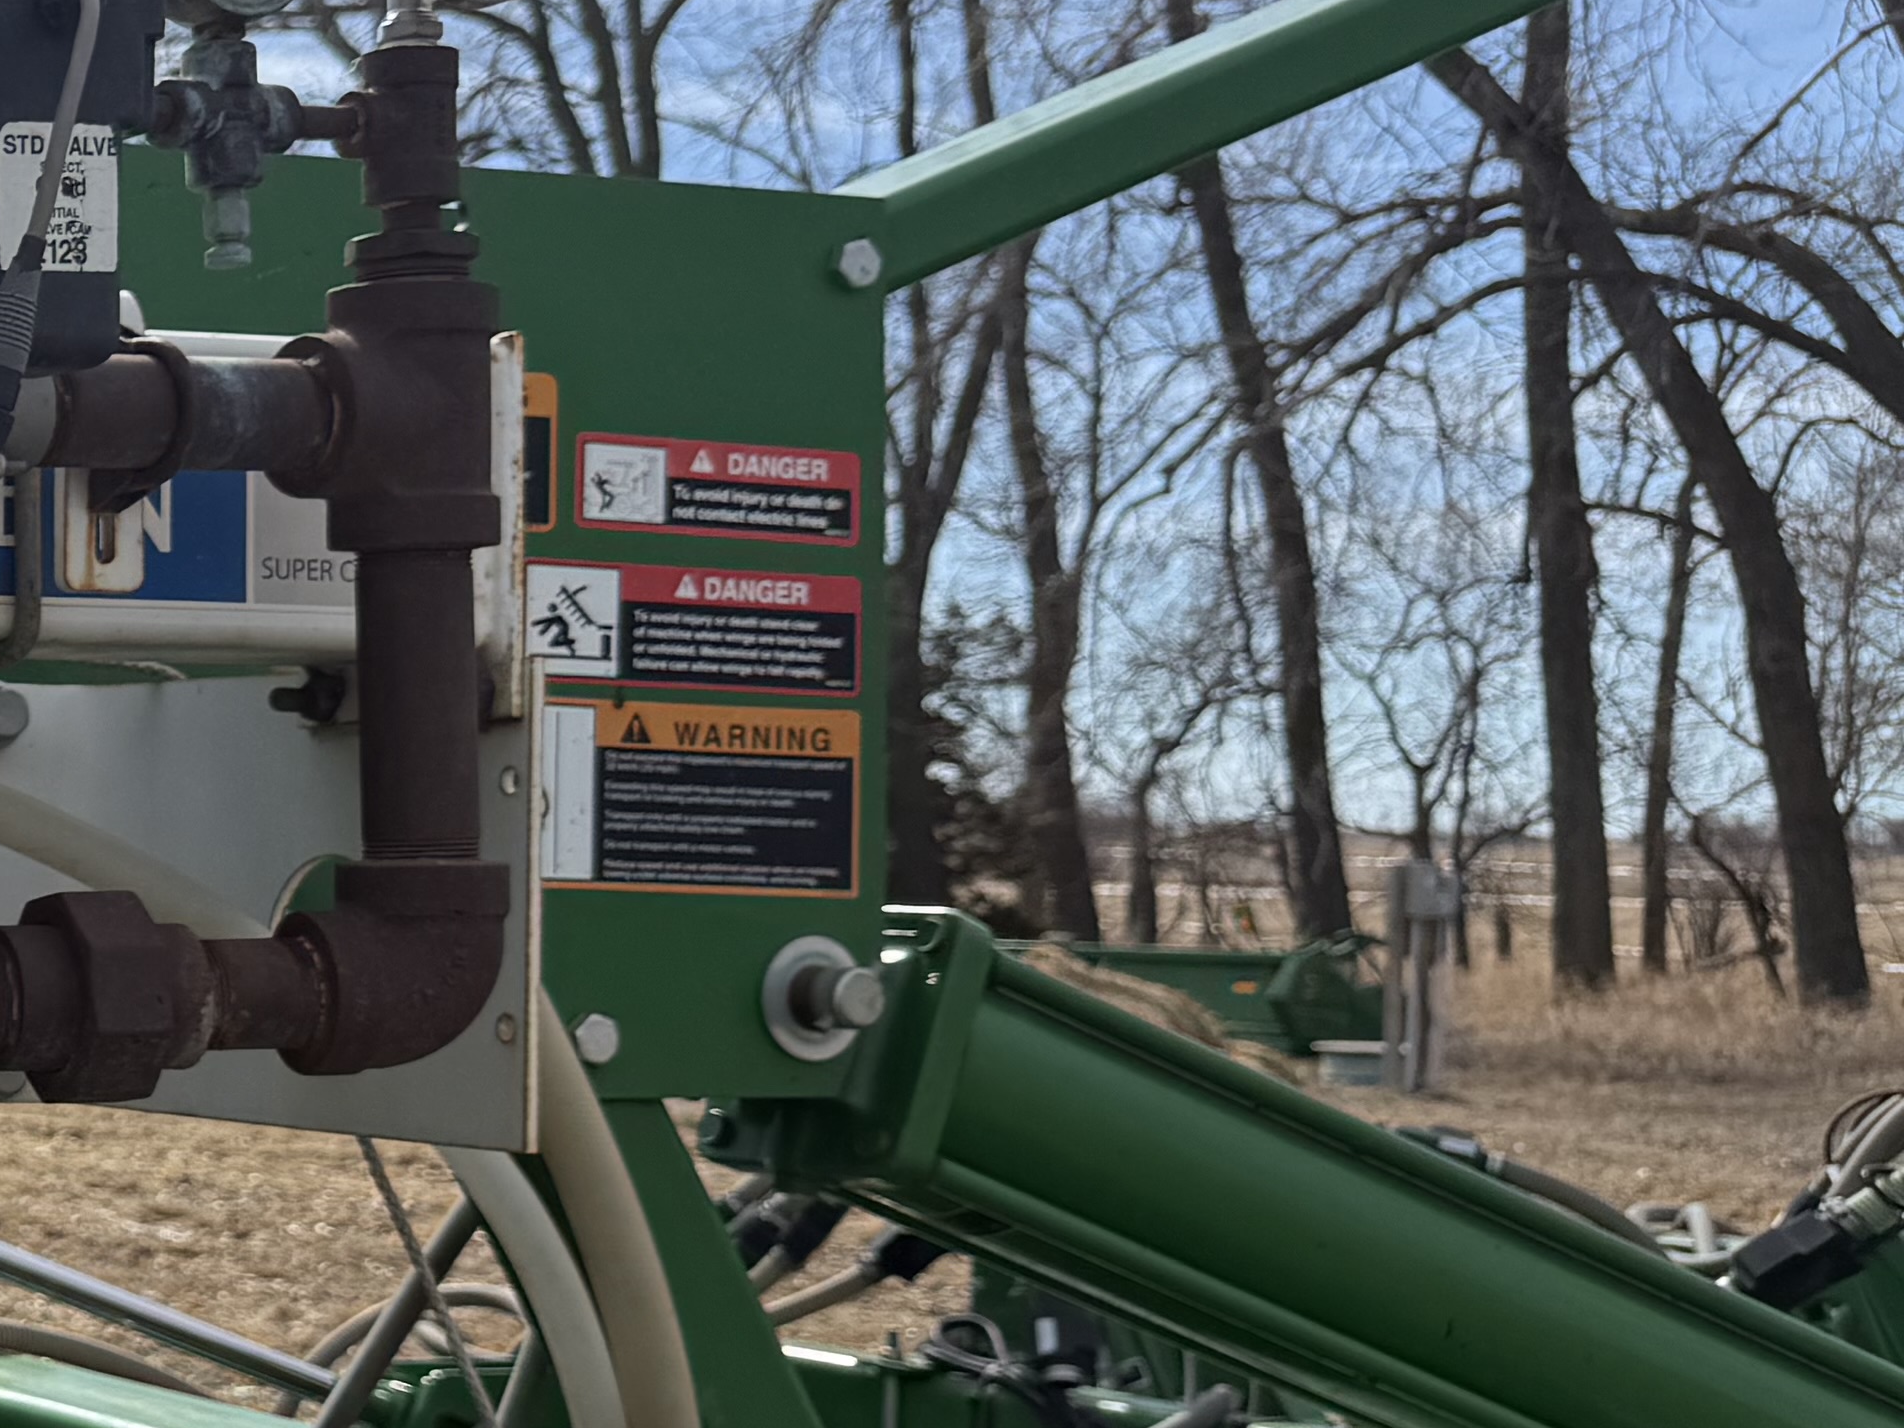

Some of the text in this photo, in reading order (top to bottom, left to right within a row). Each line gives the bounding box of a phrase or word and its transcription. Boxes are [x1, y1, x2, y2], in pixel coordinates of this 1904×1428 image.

[3, 135, 117, 156] STD ALVE
[727, 453, 829, 481] DANGER
[261, 556, 333, 582] SUPER
[704, 577, 810, 605] DANGER
[674, 721, 832, 752] WARNING
